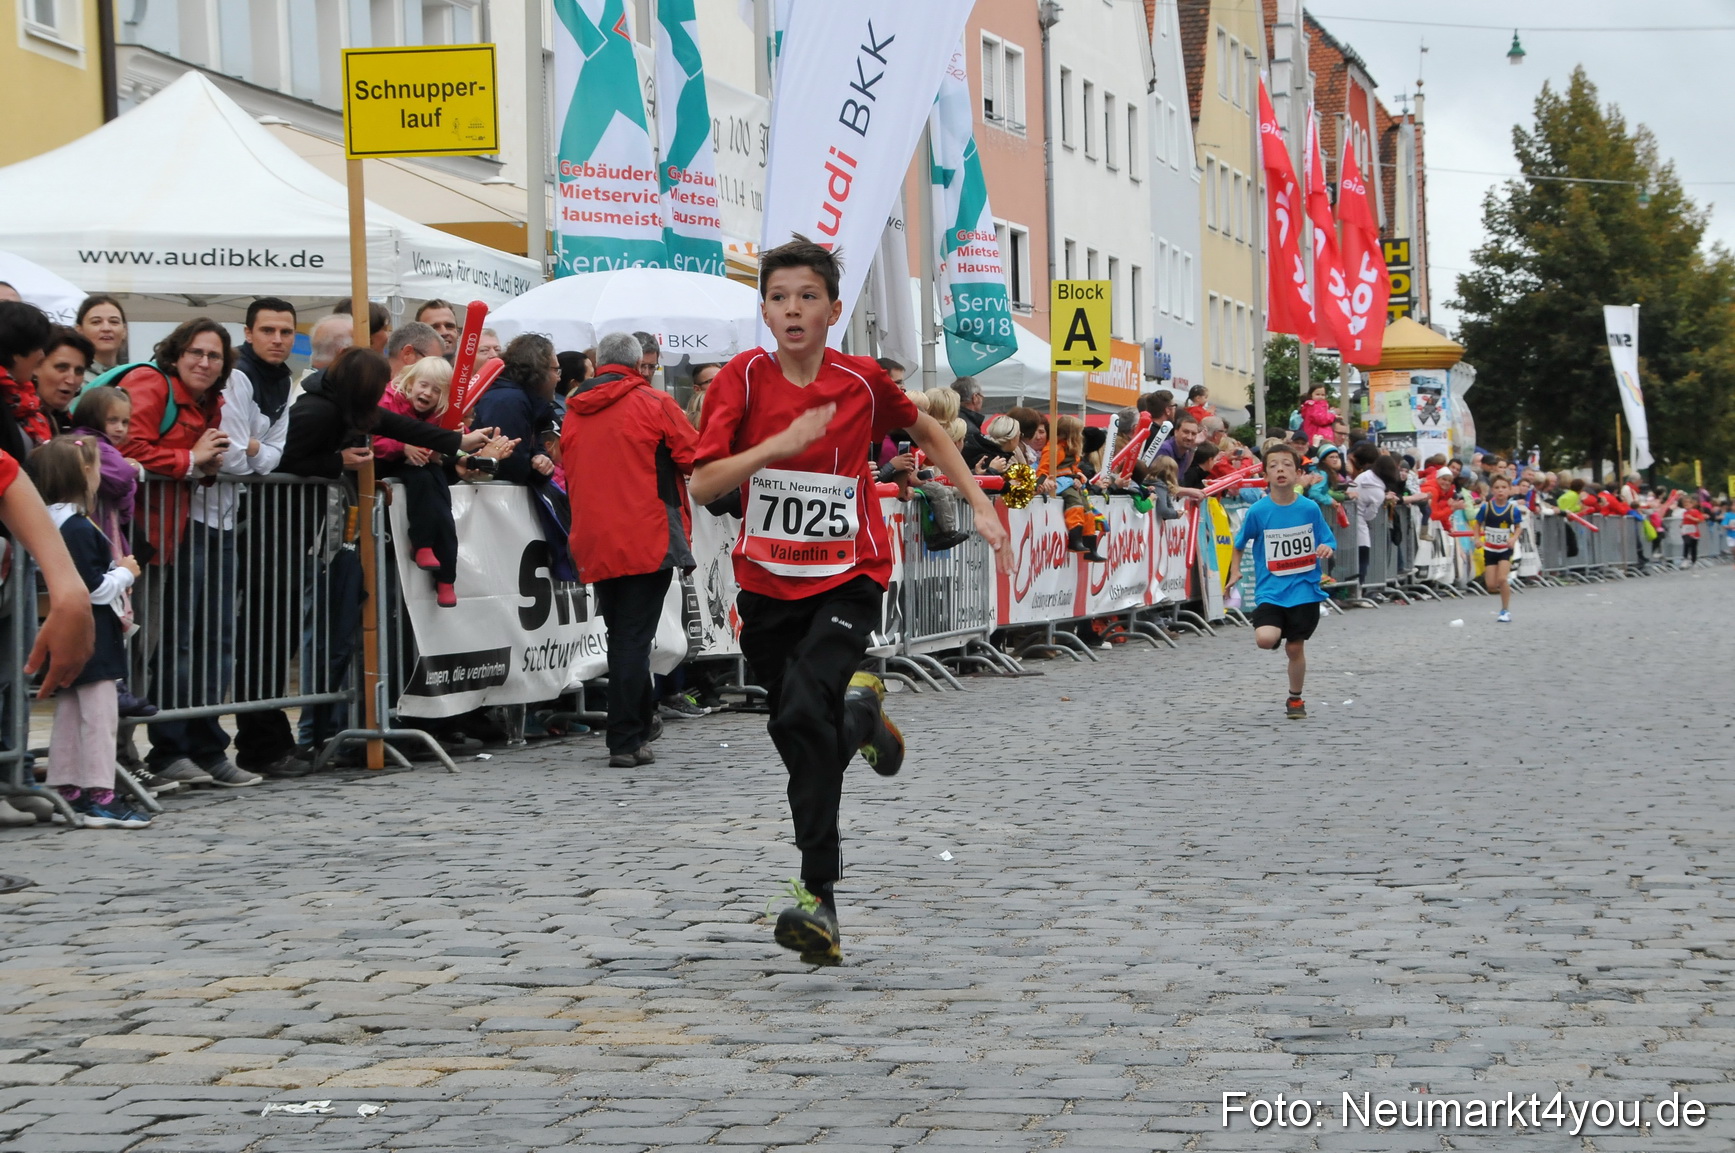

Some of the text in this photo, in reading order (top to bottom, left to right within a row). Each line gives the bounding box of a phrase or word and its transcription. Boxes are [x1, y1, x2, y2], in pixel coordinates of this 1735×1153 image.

[355, 79, 486, 103] Schnupper-
[401, 107, 442, 129] lauf
[815, 17, 896, 251] udi BKK
[667, 165, 717, 187] Gebäu
[559, 182, 661, 205] Mietservic
[956, 229, 997, 242] Gebäu
[78, 248, 325, 268] www.audibkk.de
[493, 270, 512, 294] Audi
[1058, 283, 1104, 300] Block
[958, 293, 1010, 313] Servi
[959, 316, 1012, 337] 0918
[1062, 307, 1097, 352] A
[668, 333, 709, 348] BKK
[453, 364, 470, 410] Audi BKK
[752, 477, 841, 497] PARTL Neumarkt
[759, 494, 850, 538] 7025
[770, 544, 829, 561] Valentin
[1270, 536, 1312, 558] 7099
[453, 664, 465, 682] die
